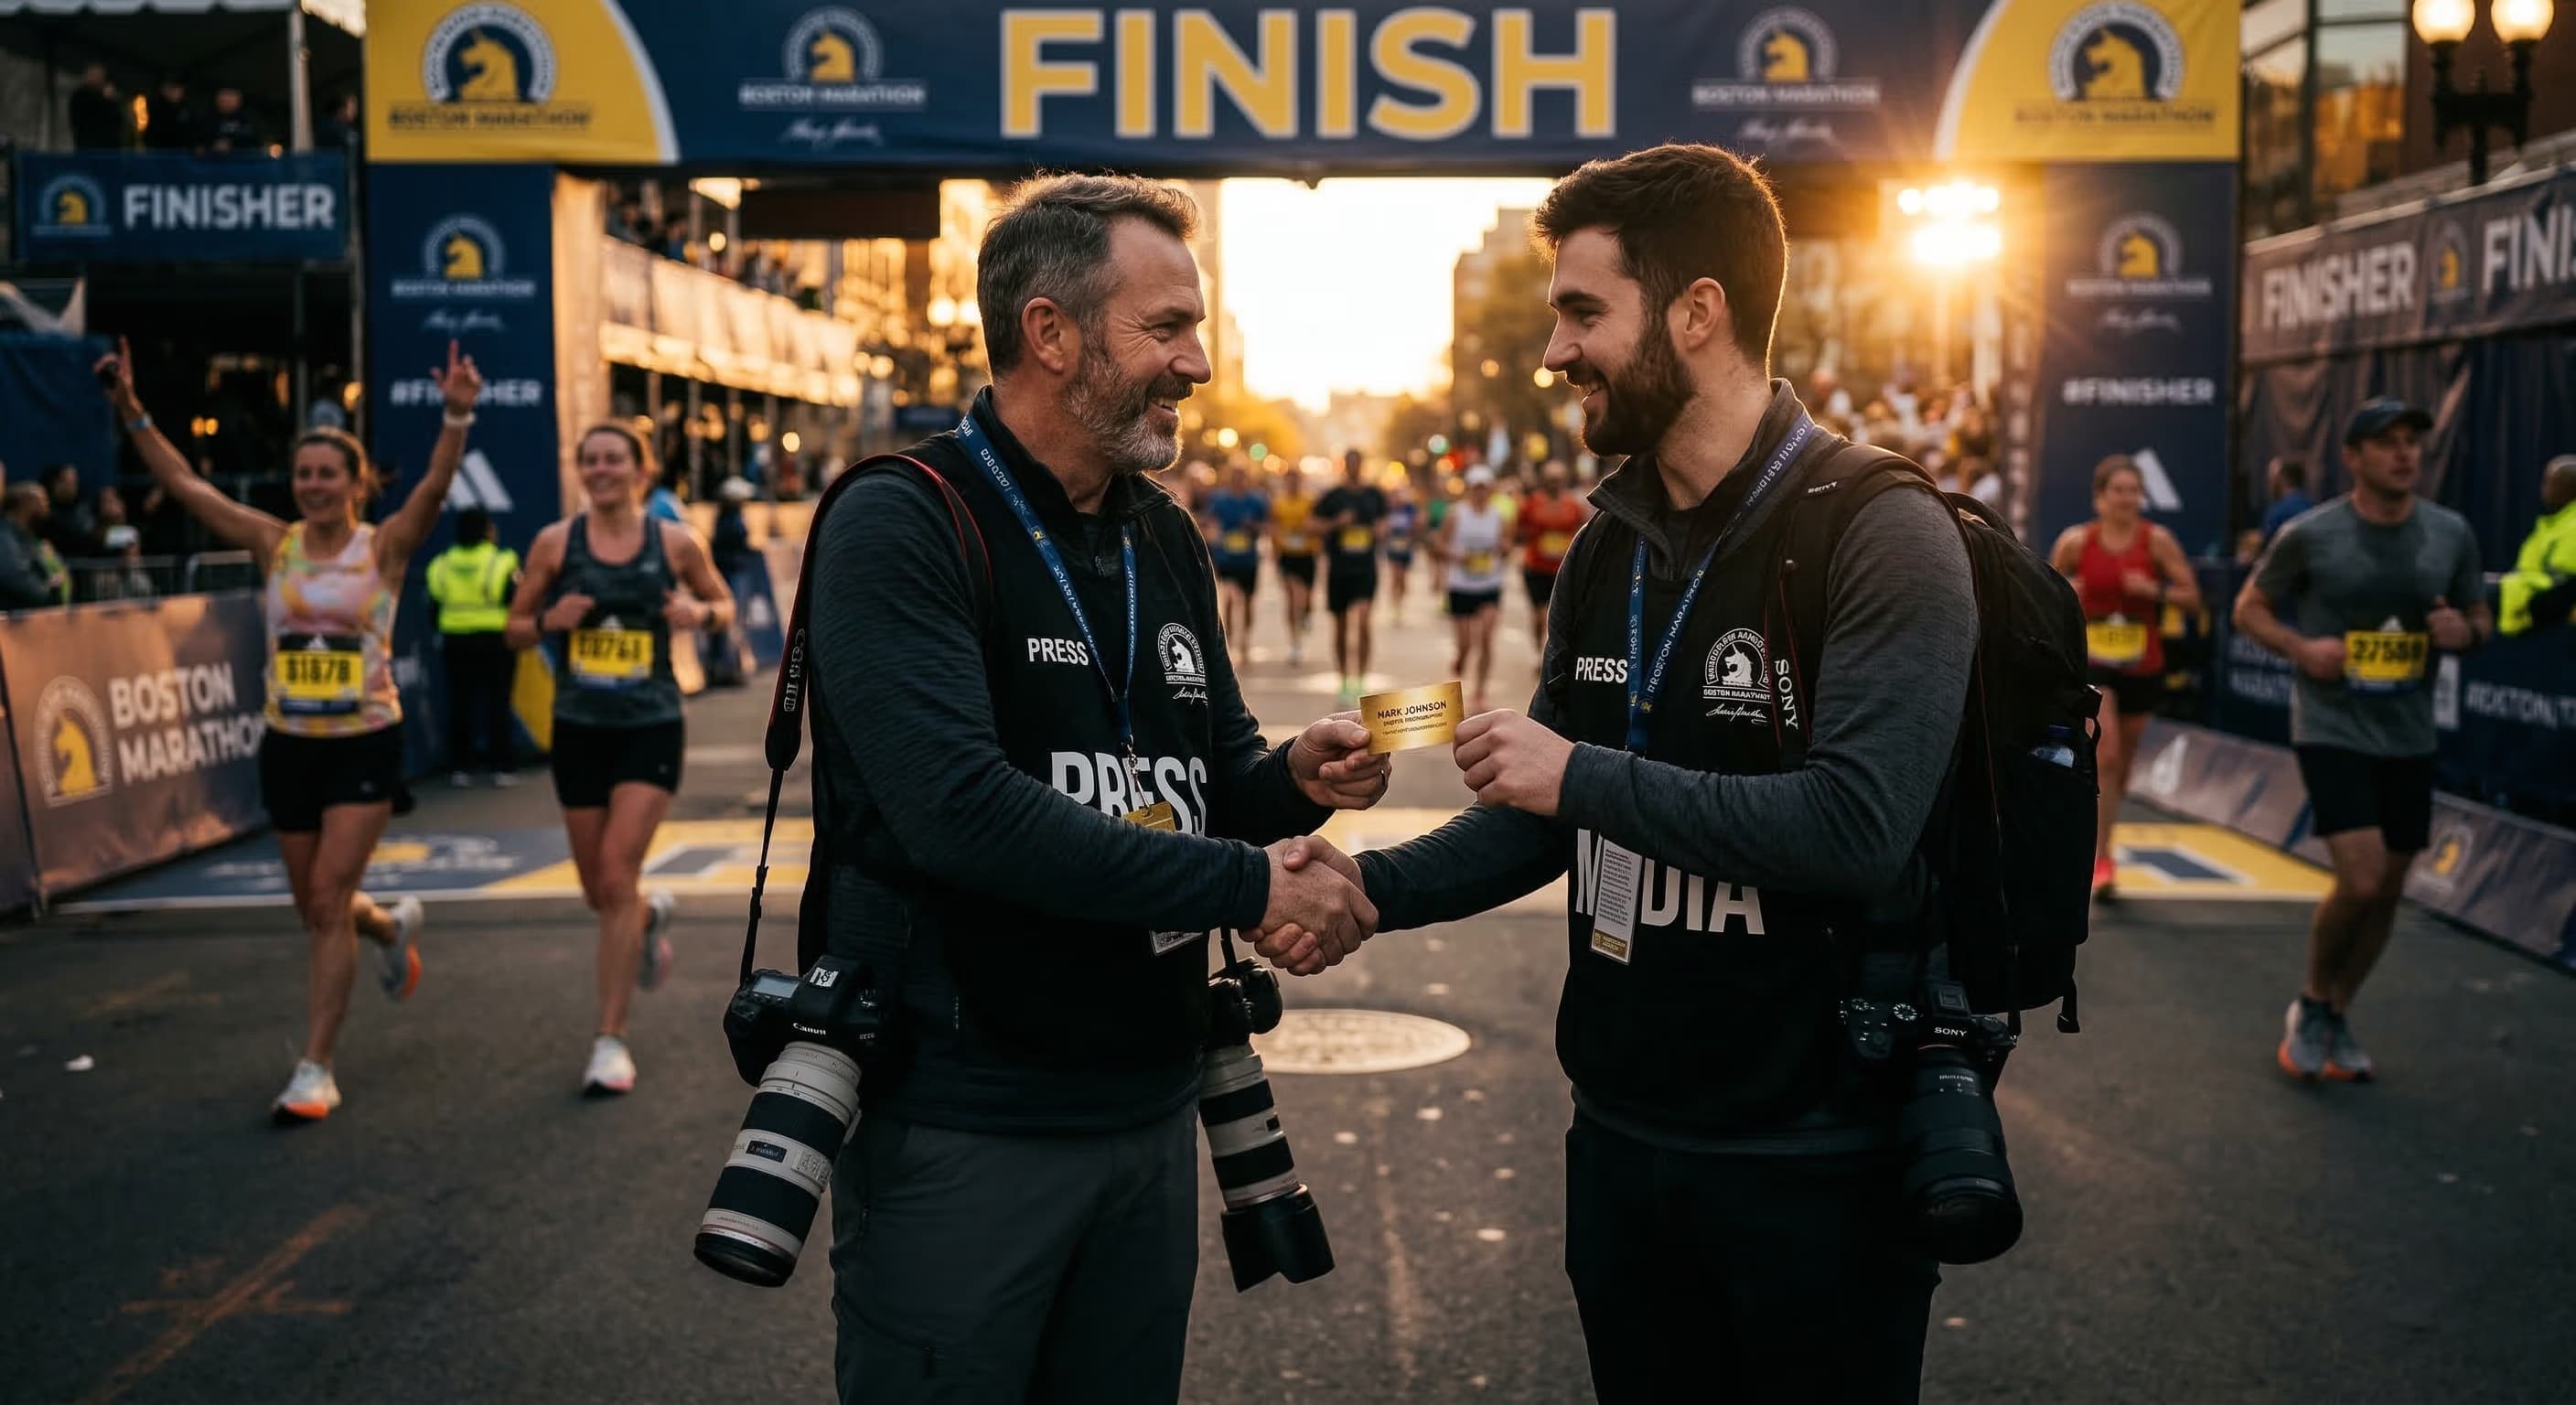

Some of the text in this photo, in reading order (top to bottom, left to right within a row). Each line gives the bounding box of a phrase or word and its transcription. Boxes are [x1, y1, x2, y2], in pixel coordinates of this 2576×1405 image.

[1001, 8, 1617, 140] FINISH
[122, 184, 336, 229] FINISHER
[2482, 204, 2576, 295] FINI
[2263, 242, 2415, 328] FINISHER
[2063, 377, 2216, 406] #FINISHER
[1027, 638, 1089, 666] PRESS
[1575, 657, 1628, 683] PRESS
[111, 665, 235, 726] BOSTON
[1378, 708, 1403, 720] MARK
[1405, 701, 1447, 715] JOHNSON
[1775, 659, 1799, 730] SONY
[1051, 751, 1208, 839] PRESS
[1575, 827, 1766, 935] MDIA
[1934, 1026, 1968, 1037] SONY
